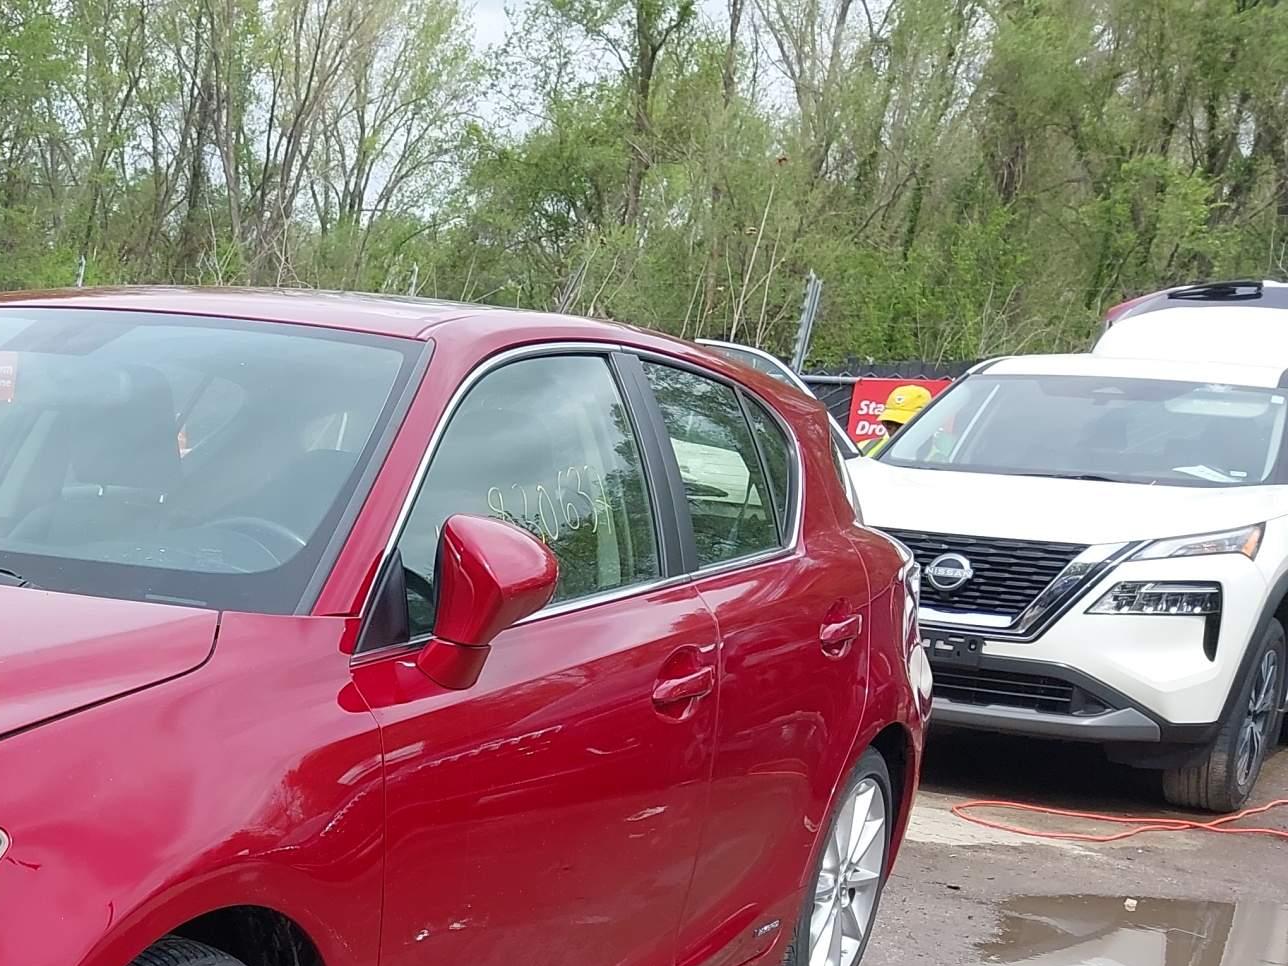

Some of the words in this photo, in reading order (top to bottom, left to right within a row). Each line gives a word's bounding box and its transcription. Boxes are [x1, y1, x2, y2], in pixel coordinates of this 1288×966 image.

[857, 399, 885, 415] Sta
[855, 420, 887, 436] Dro
[925, 565, 973, 579] NISSAN
